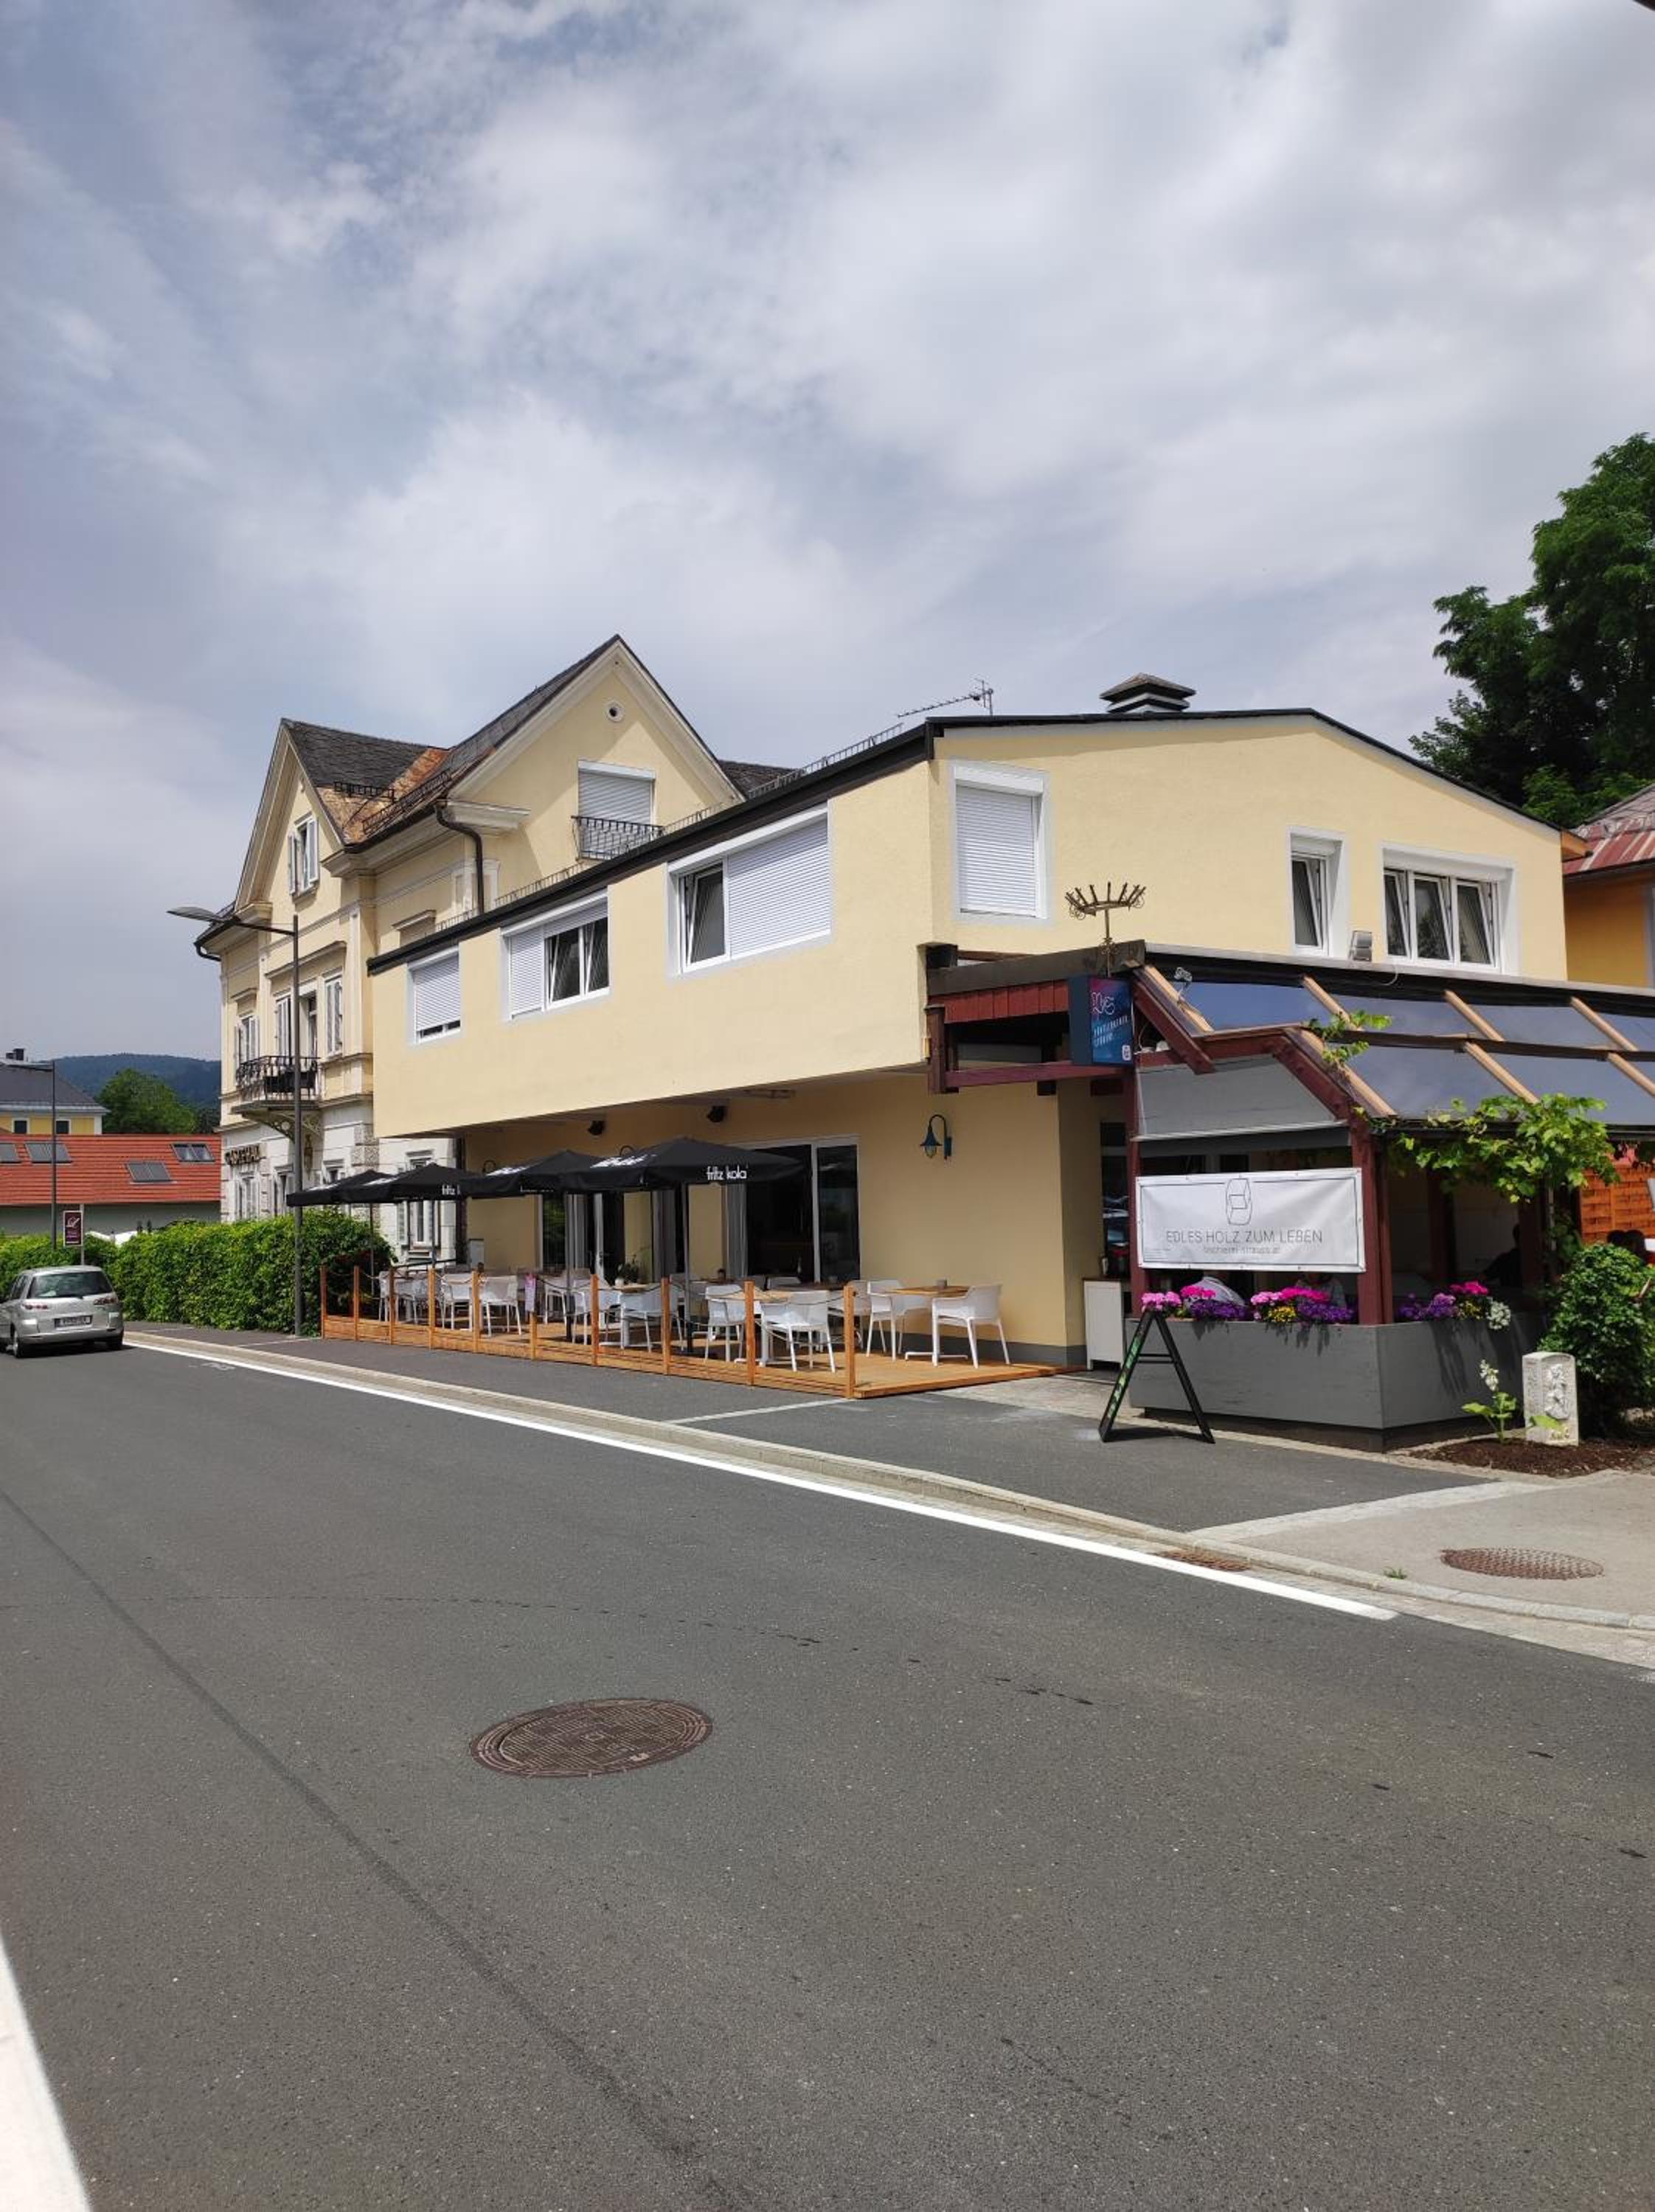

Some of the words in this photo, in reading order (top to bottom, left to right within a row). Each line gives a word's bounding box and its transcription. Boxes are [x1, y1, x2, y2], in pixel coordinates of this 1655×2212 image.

[1166, 1231, 1202, 1243] EDLES
[1206, 1230, 1240, 1244] HOLZ
[1245, 1230, 1275, 1243] ZUM
[1280, 1229, 1322, 1244] LEBEN
